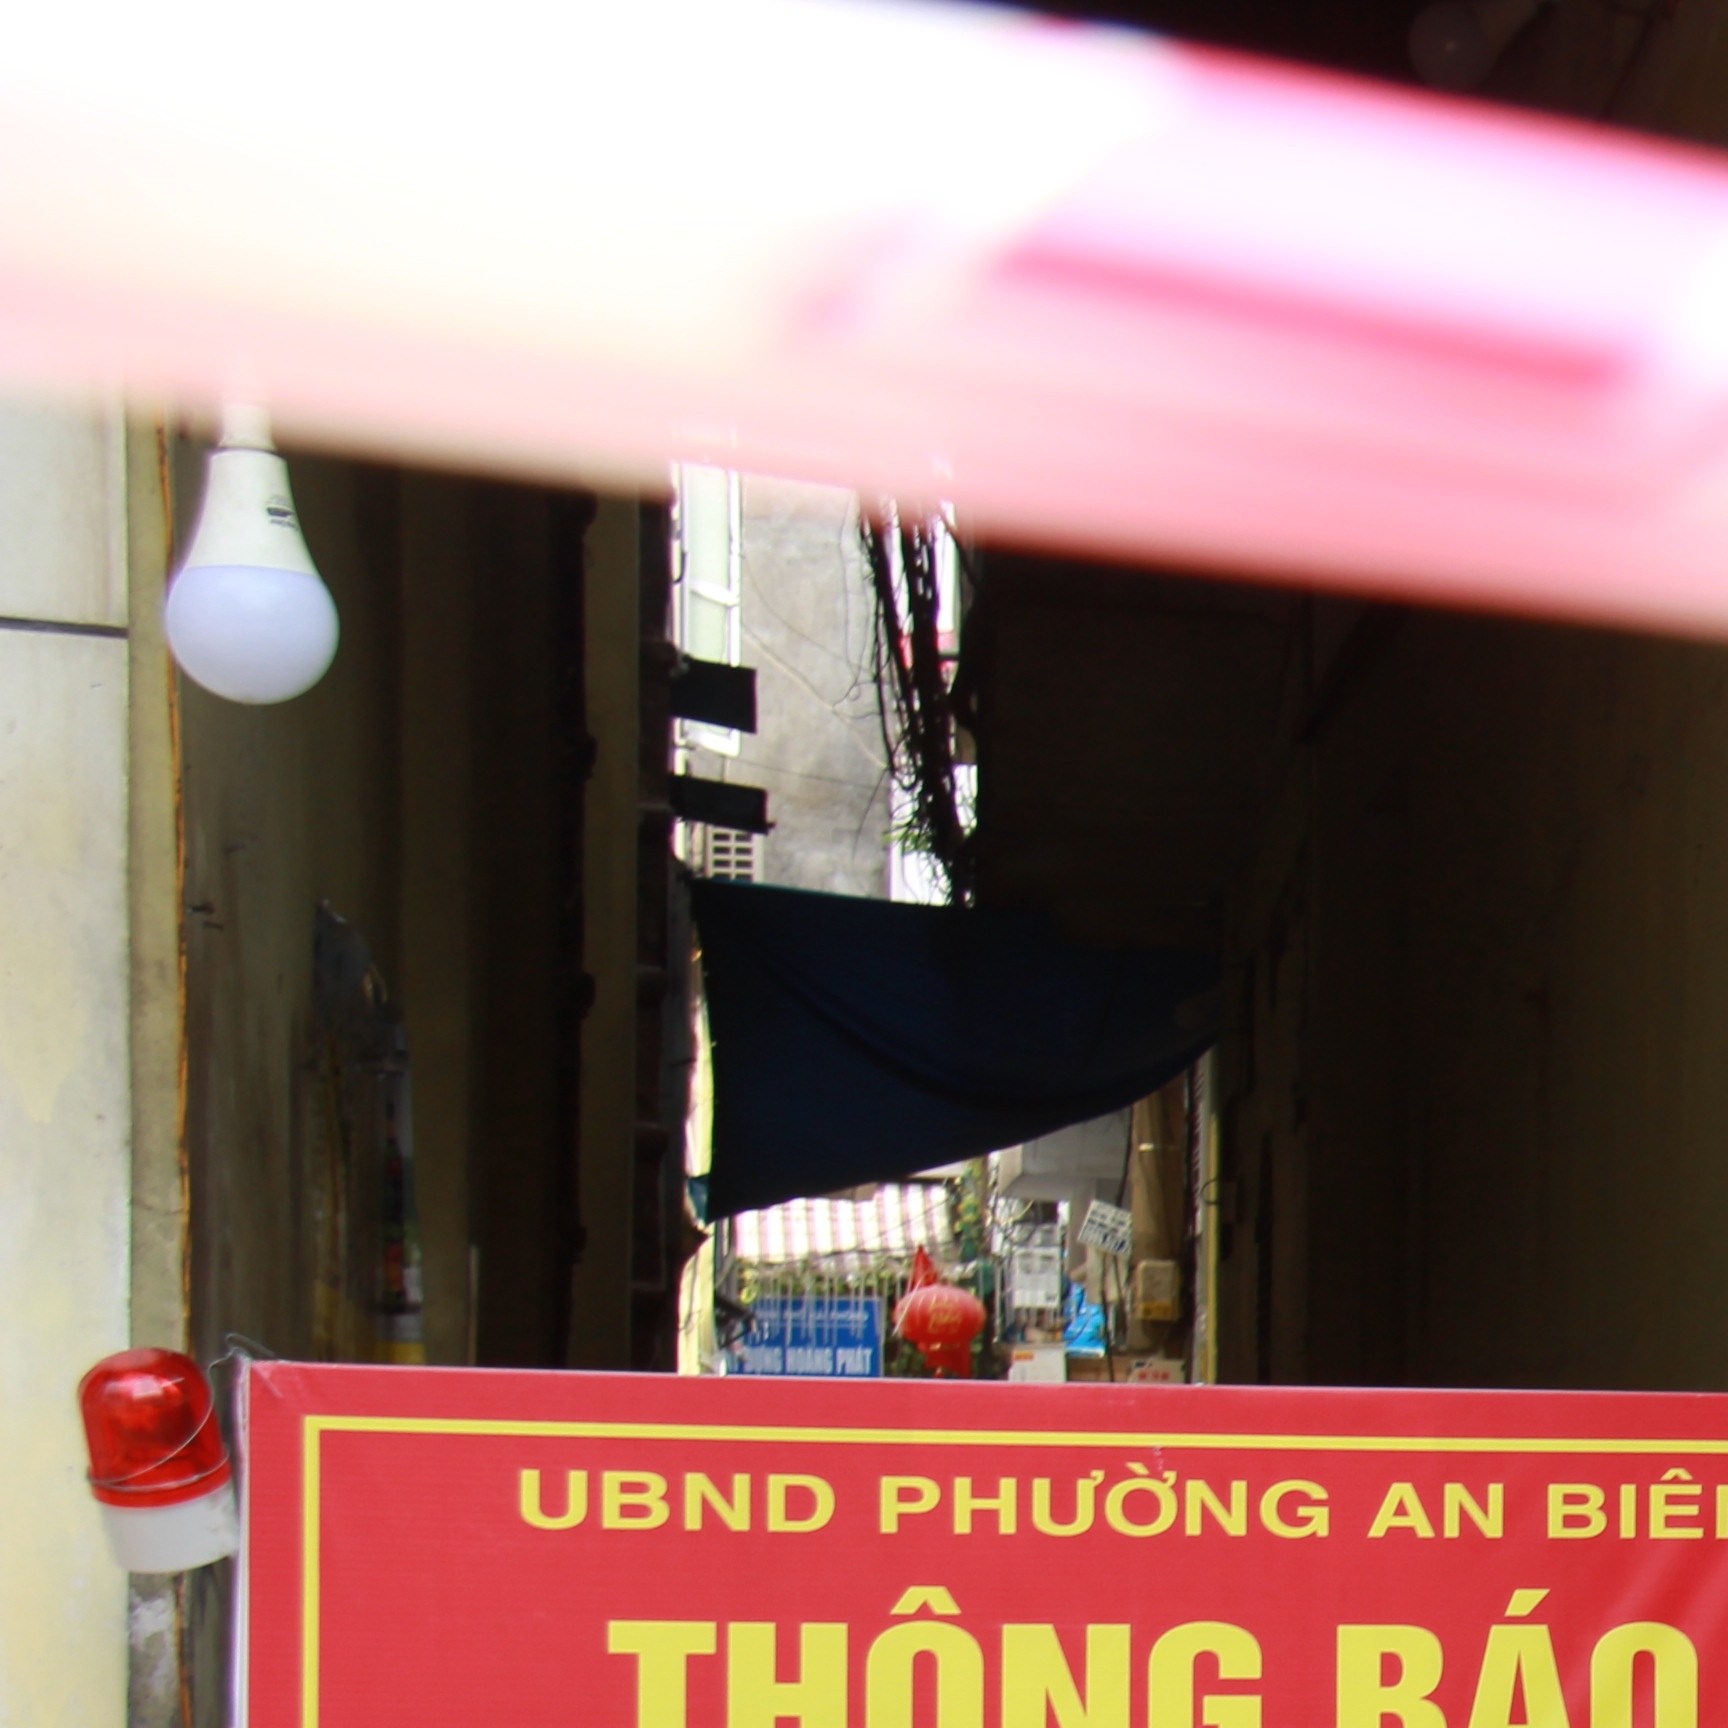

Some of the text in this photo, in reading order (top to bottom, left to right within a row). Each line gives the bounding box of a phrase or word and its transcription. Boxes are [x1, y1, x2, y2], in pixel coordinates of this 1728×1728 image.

[519, 1468, 836, 1533] UBND
[879, 1462, 1330, 1539] PHƯỜNG
[1367, 1482, 1504, 1539] AN
